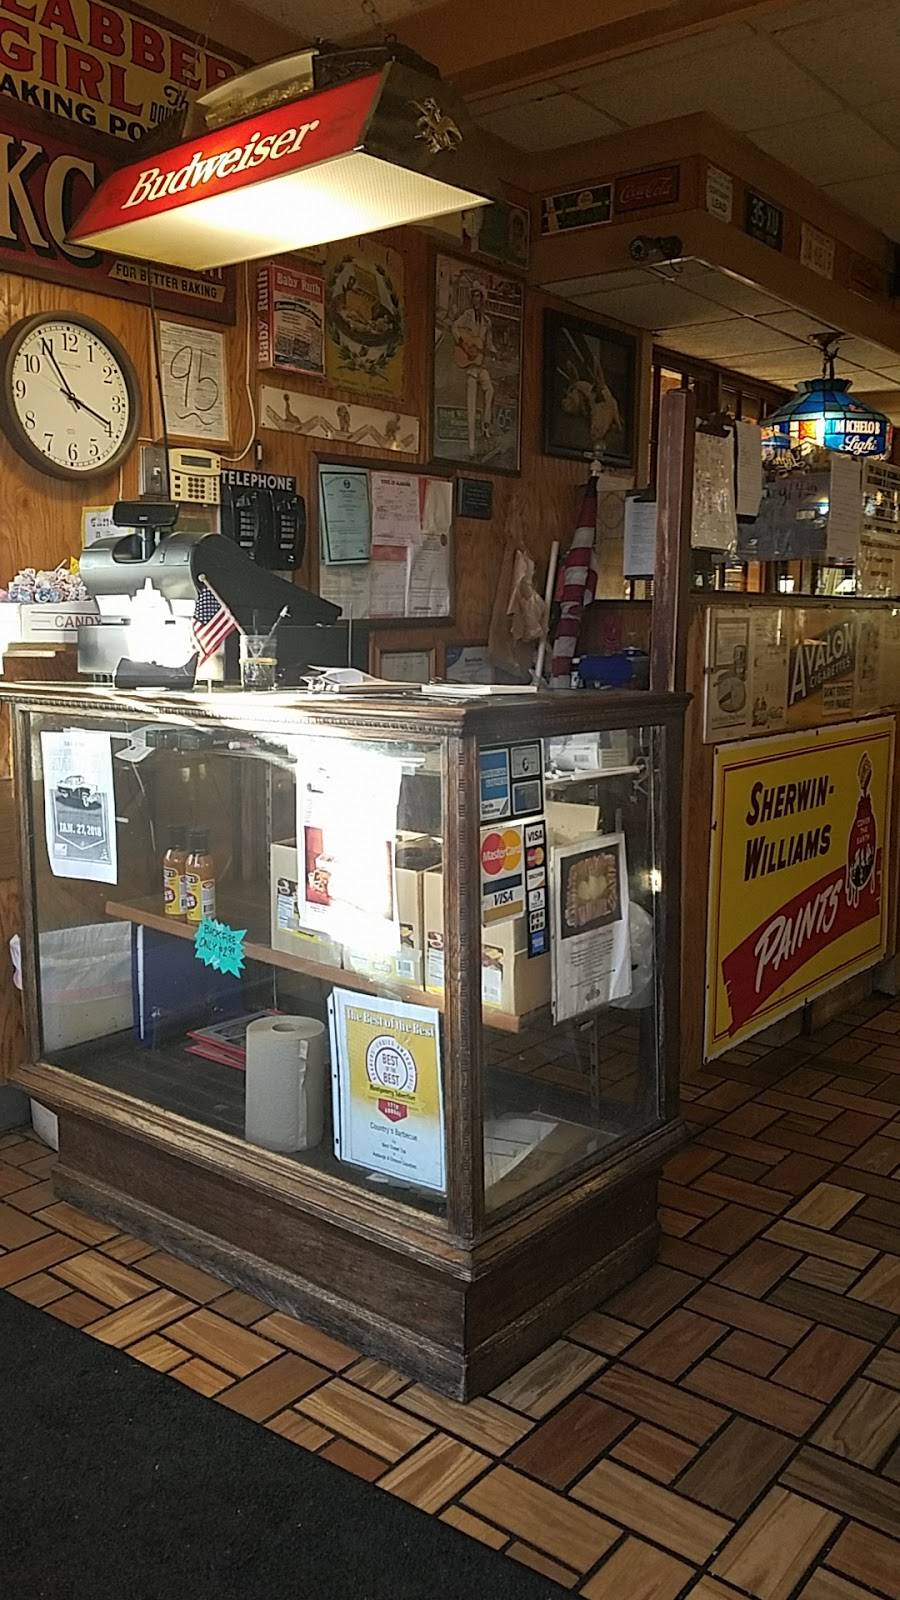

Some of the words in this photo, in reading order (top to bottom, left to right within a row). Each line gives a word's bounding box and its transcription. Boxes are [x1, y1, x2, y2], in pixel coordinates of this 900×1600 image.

[0, 16, 143, 117] GIRL
[164, 85, 189, 111] Th
[109, 112, 149, 141] PO
[121, 119, 320, 209] Budweiser
[116, 263, 136, 280] FOR
[140, 269, 178, 290] BETTER
[181, 281, 217, 299] BAKING
[277, 272, 298, 290] Baby
[302, 280, 321, 296] Ruth
[258, 270, 269, 312] Ruth
[62, 333, 78, 352] 12
[258, 319, 269, 362] Baby
[24, 354, 40, 373] 10
[88, 345, 93, 363] 1
[103, 366, 112, 384] 2
[170, 346, 219, 411] 95
[16, 380, 25, 398] 9
[112, 396, 121, 413] 3
[25, 410, 36, 429] 8
[835, 420, 880, 434] MICHELOB
[44, 433, 54, 451] 7
[68, 443, 77, 460] 6
[90, 438, 99, 456] 5
[838, 435, 877, 455] Light
[221, 471, 293, 491] TELEPHONE
[54, 615, 101, 629] CANDY
[789, 623, 854, 705] AVALON
[745, 776, 834, 826] SHERWIN-
[528, 830, 543, 842] VISA
[483, 847, 521, 862] MasterCard
[744, 824, 832, 883] WILLIAMS
[494, 890, 514, 906] VISA
[754, 879, 843, 993] PAINTS
[347, 1008, 362, 1020] The
[363, 1011, 382, 1026] Best
[383, 1017, 395, 1029] of
[396, 1019, 411, 1032] the
[413, 1023, 434, 1037] Best
[382, 1053, 398, 1067] BEST
[383, 1072, 399, 1086] BEST
